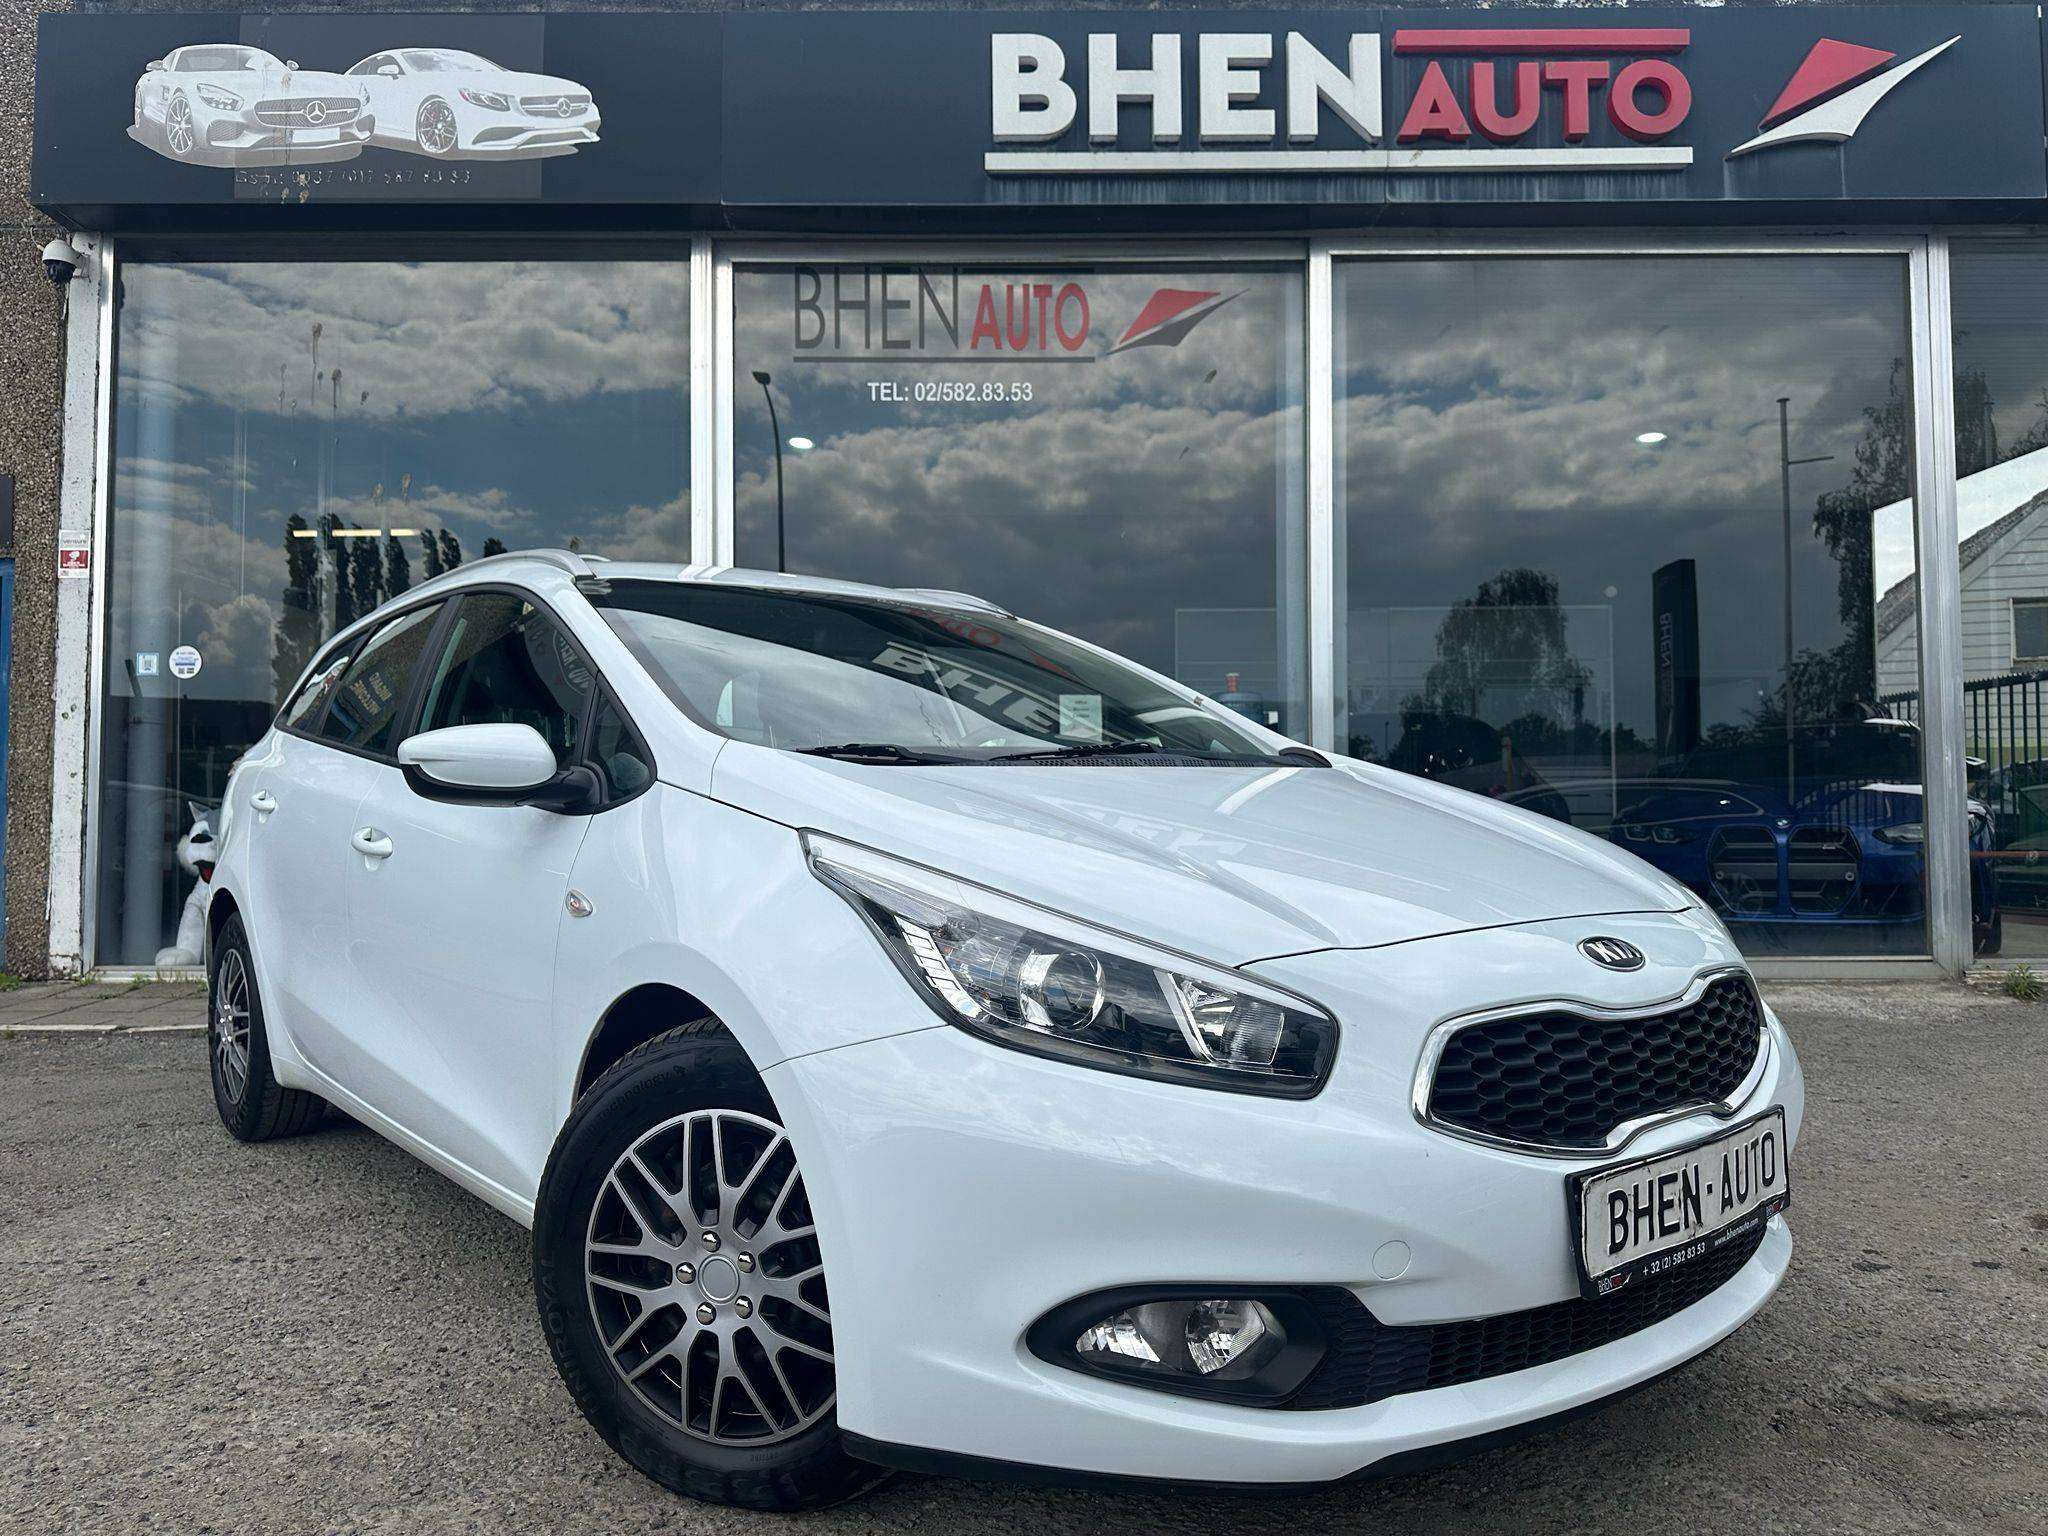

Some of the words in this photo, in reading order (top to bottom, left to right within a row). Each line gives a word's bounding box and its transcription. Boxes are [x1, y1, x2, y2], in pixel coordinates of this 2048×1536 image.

[991, 31, 1383, 145] BHEN
[1396, 59, 1693, 143] AUTO
[794, 266, 960, 350] BHEN
[970, 283, 1091, 351] AUTO
[867, 381, 909, 402] TEL:
[914, 381, 1034, 403] 02/582.83.53
[1586, 940, 1642, 963] KIA
[1650, 1260, 1661, 1274] 32
[1672, 1250, 1686, 1266] 582
[1687, 1245, 1696, 1259] 83
[1696, 1241, 1706, 1255] 53
